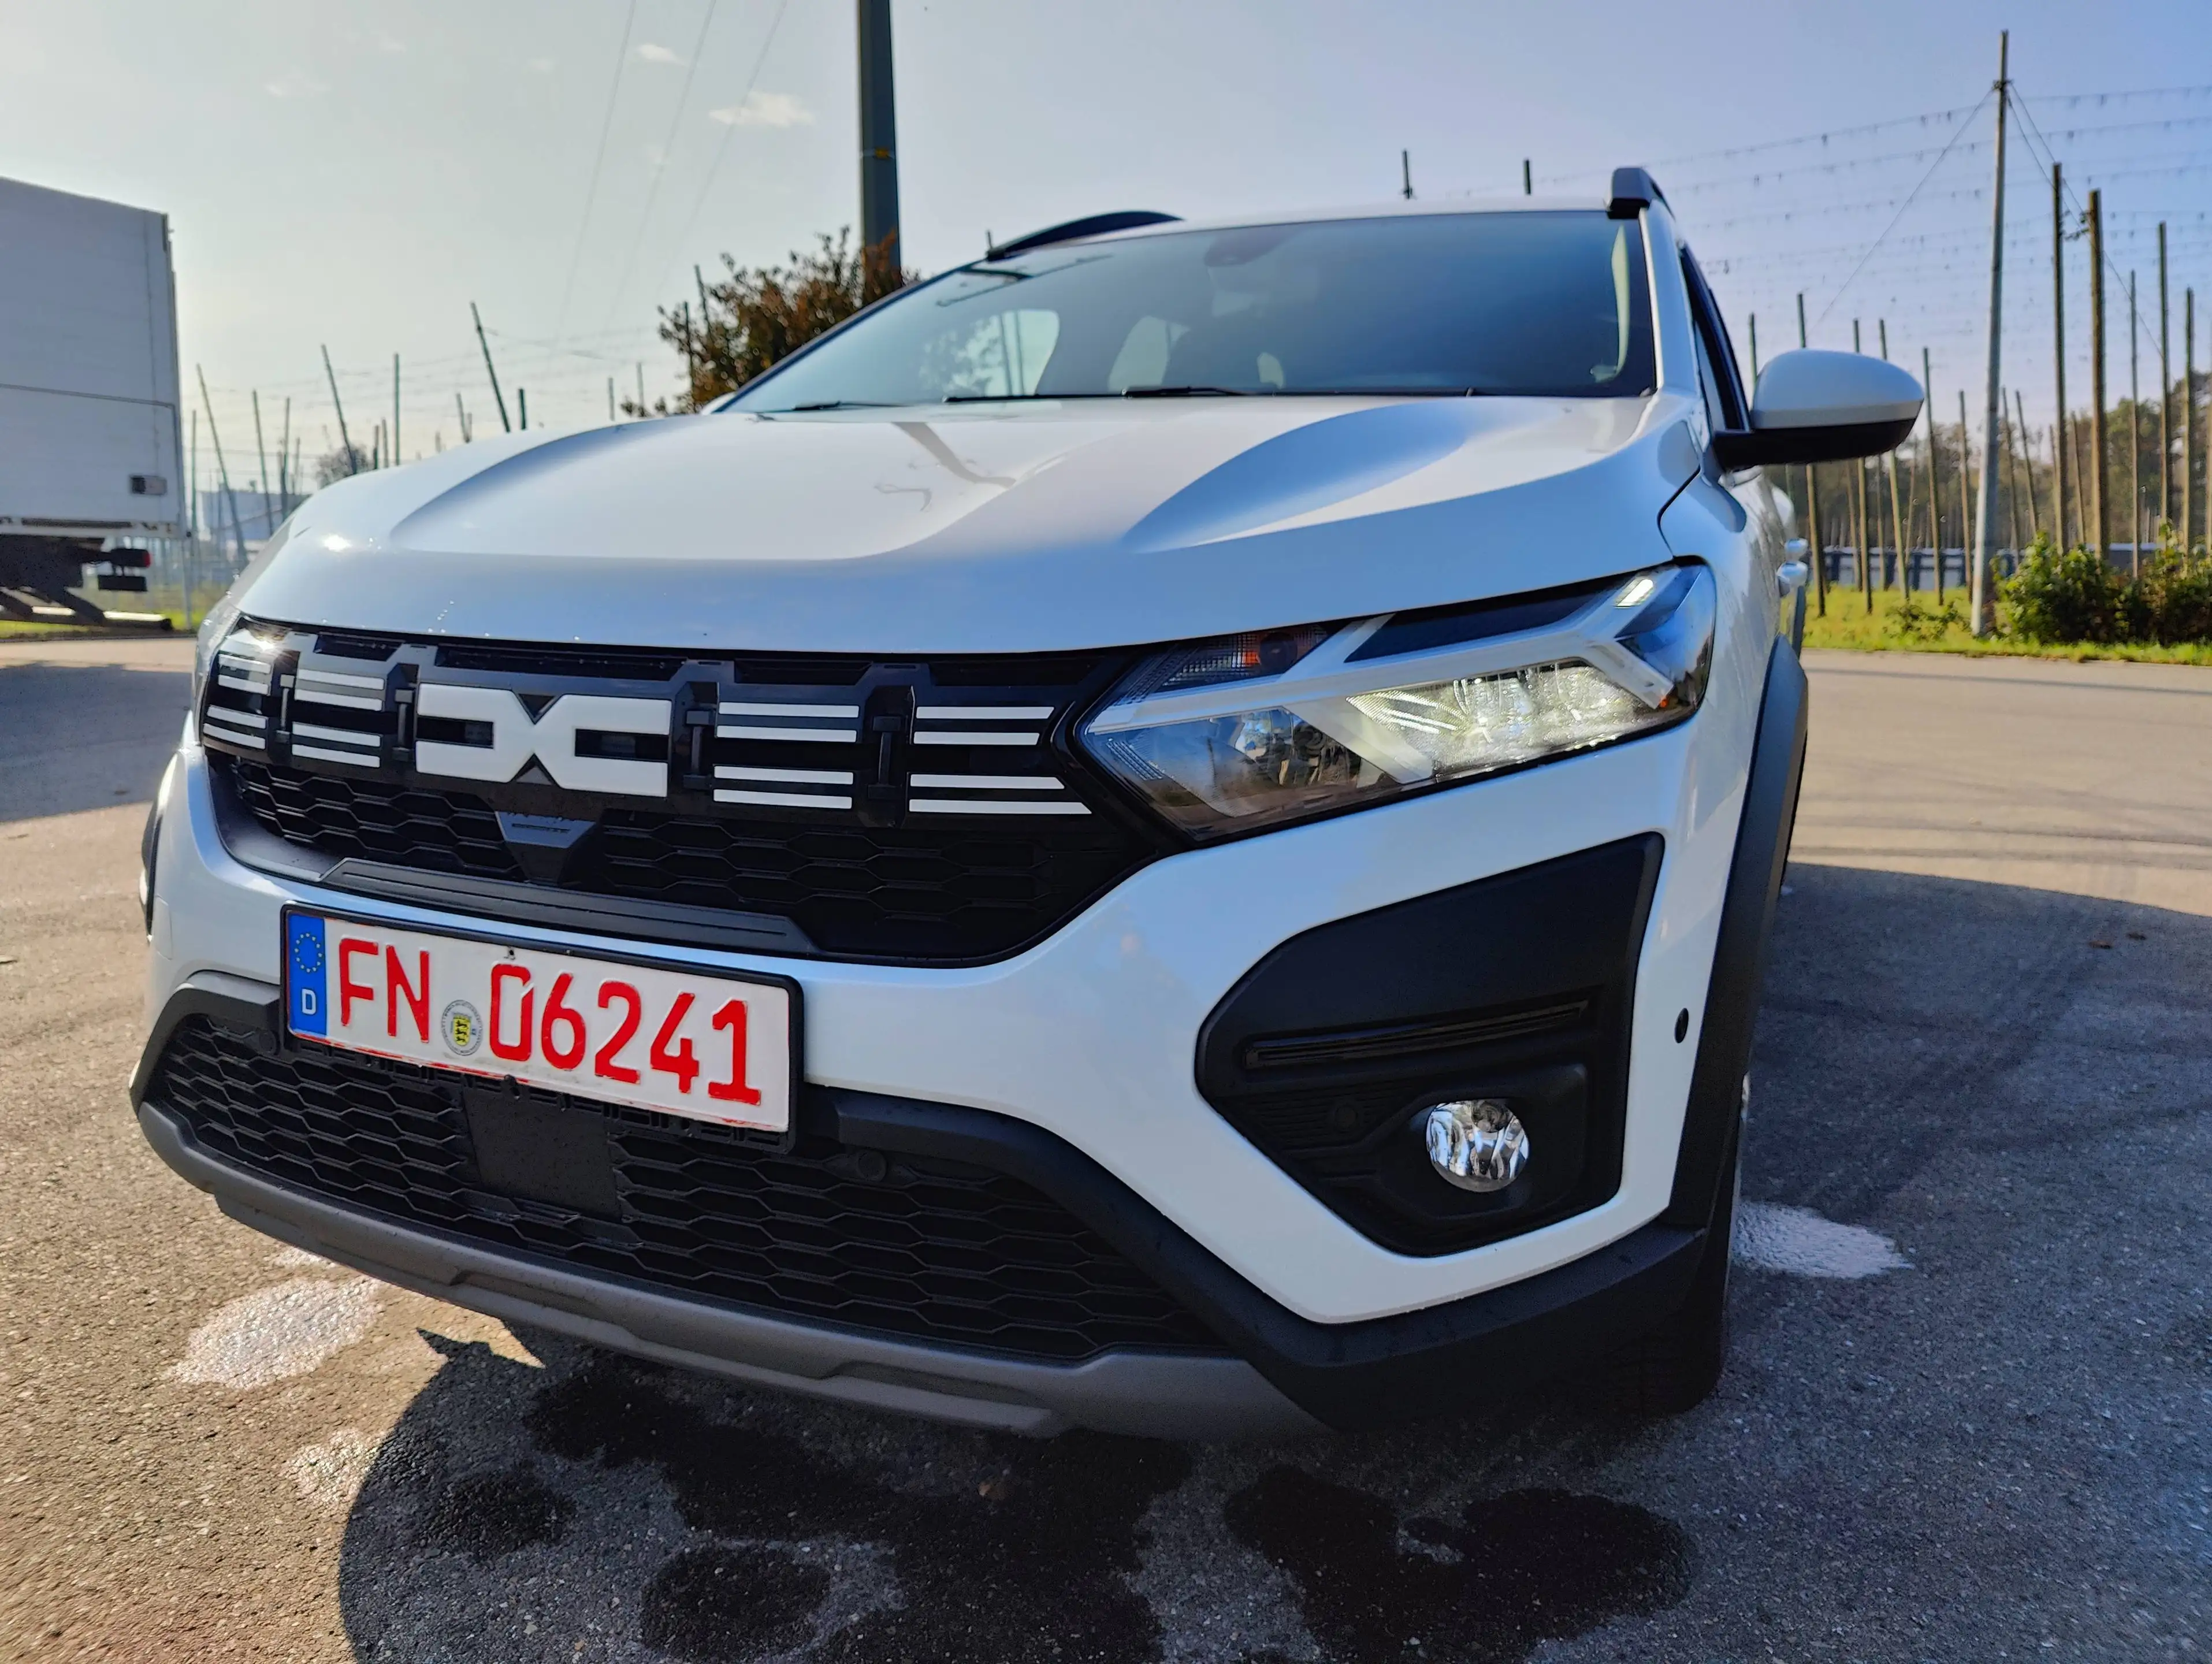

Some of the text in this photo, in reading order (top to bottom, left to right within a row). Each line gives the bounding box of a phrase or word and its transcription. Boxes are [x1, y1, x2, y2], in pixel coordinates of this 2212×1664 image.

[302, 988, 317, 1015] D
[338, 937, 430, 1043] FN
[489, 963, 761, 1106] 06241
